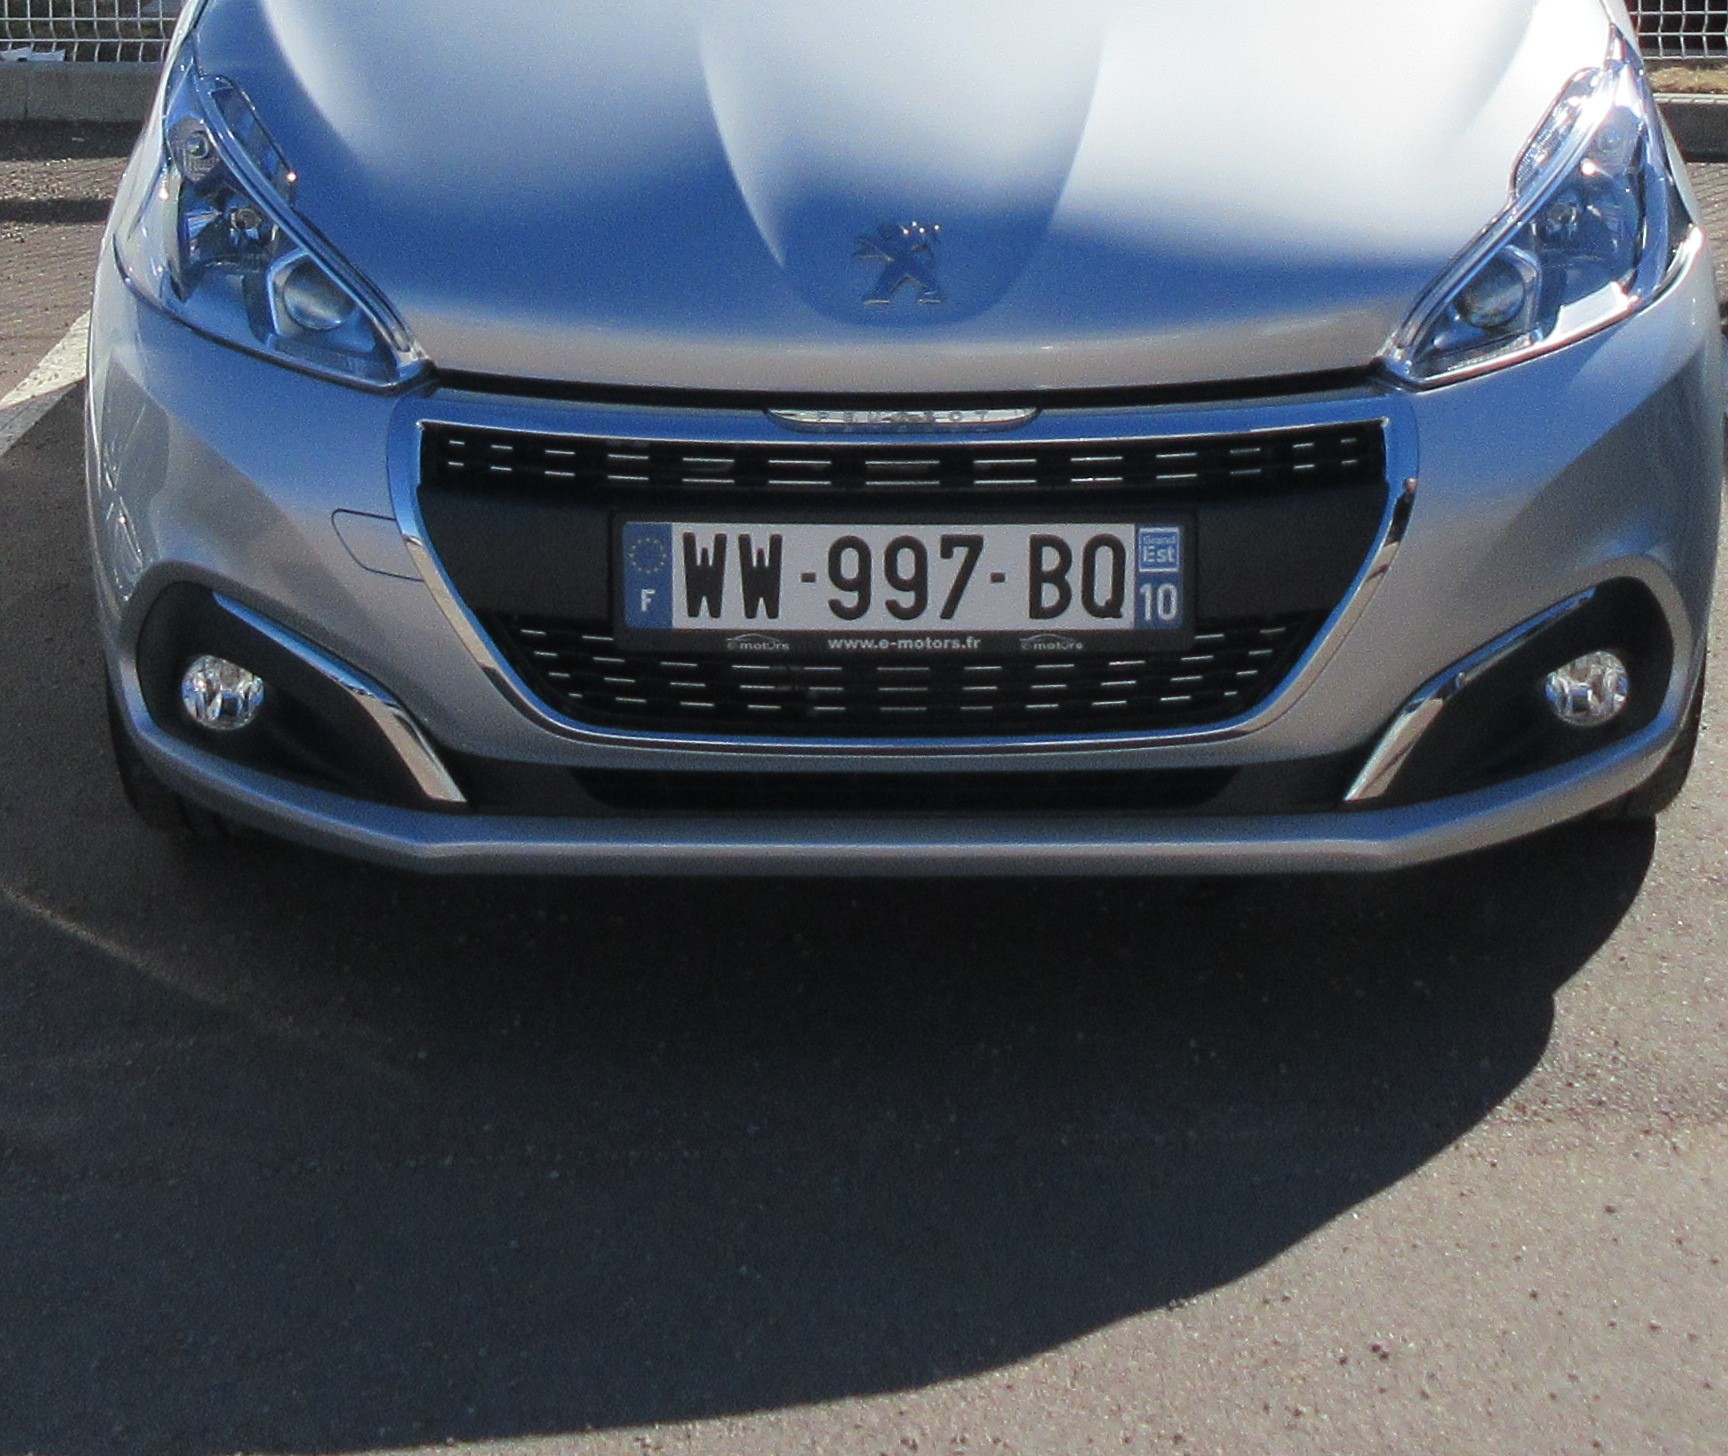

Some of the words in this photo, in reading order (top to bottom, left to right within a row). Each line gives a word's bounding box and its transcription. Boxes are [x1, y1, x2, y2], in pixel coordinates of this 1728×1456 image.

[1142, 545, 1175, 562] Est
[641, 588, 656, 612] F
[1139, 583, 1178, 621] 10
[828, 636, 980, 650] www.e-motors.fr
